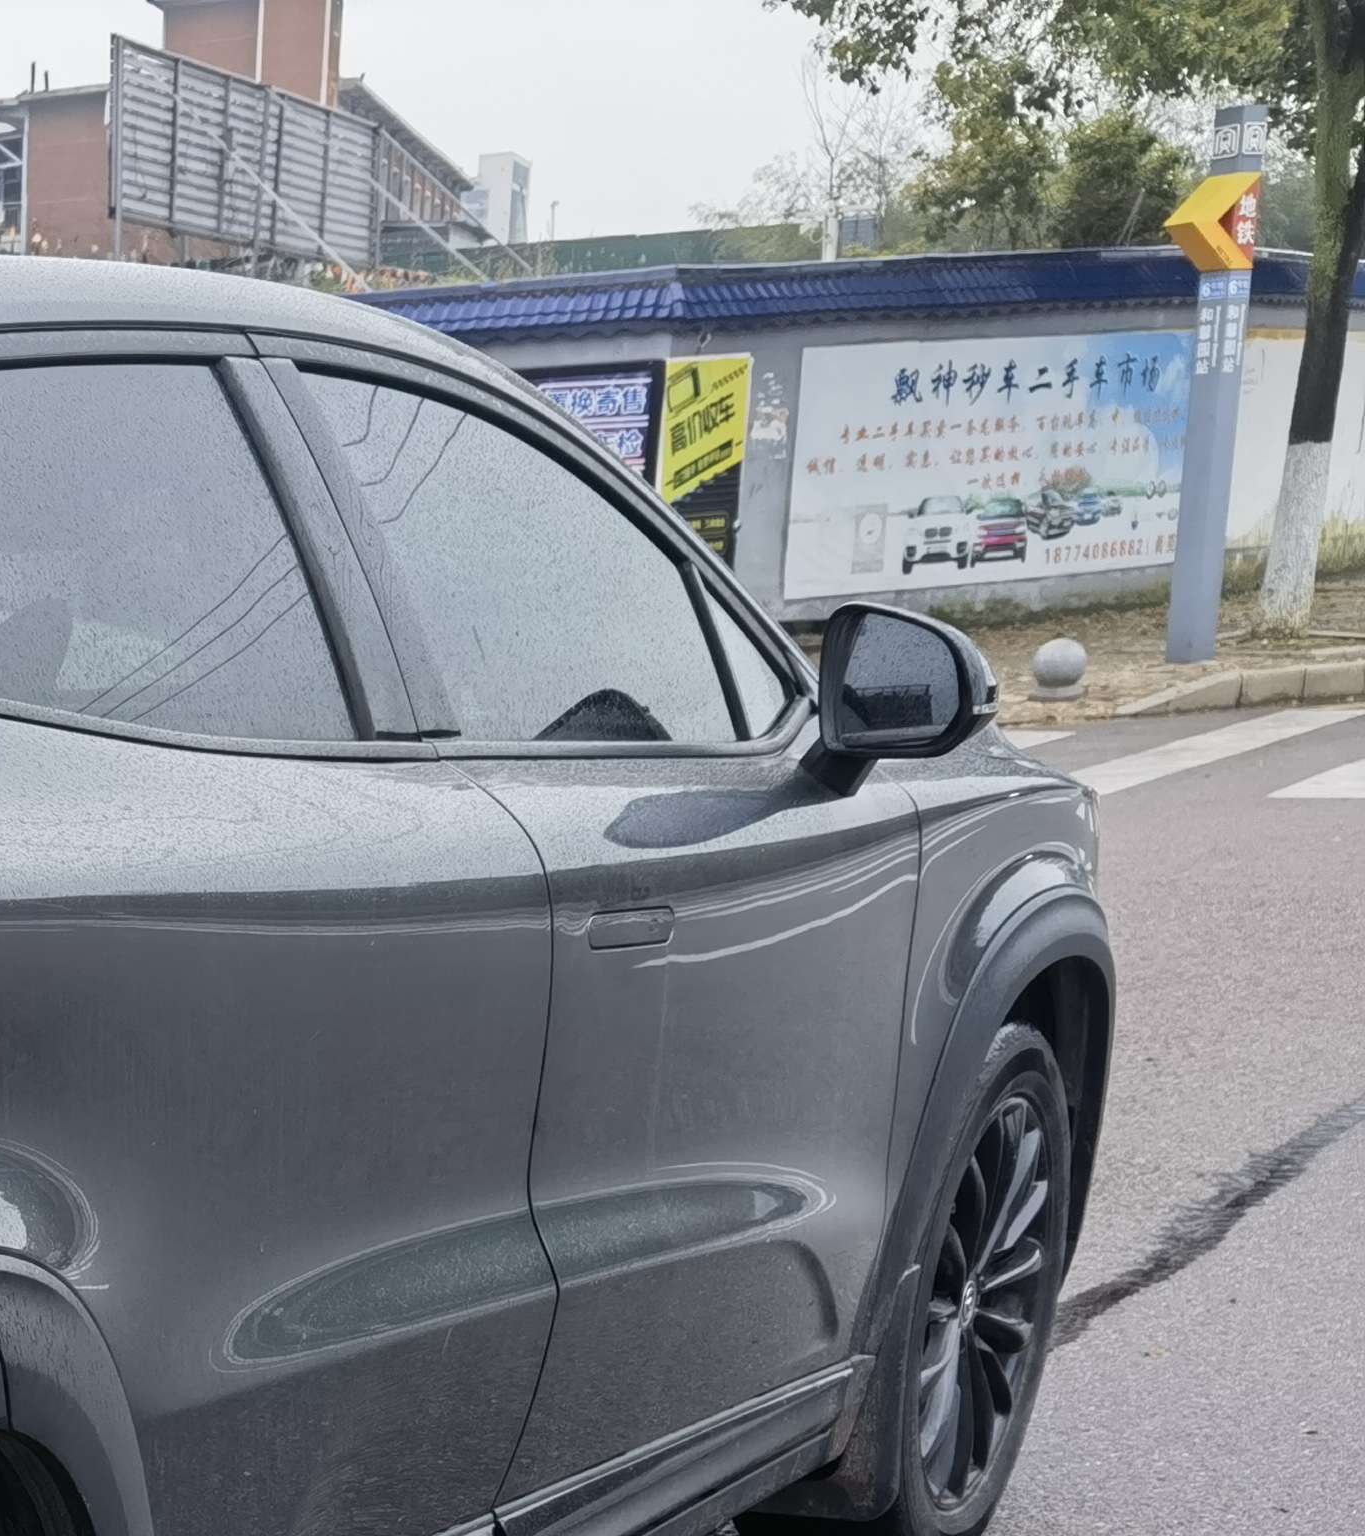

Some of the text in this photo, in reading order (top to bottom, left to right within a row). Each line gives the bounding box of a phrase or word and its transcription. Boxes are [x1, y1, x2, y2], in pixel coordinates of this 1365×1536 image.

[1236, 193, 1257, 244] 地铁
[892, 353, 1162, 406] 飘神秒车二手车市场
[670, 392, 736, 457] 高价收车
